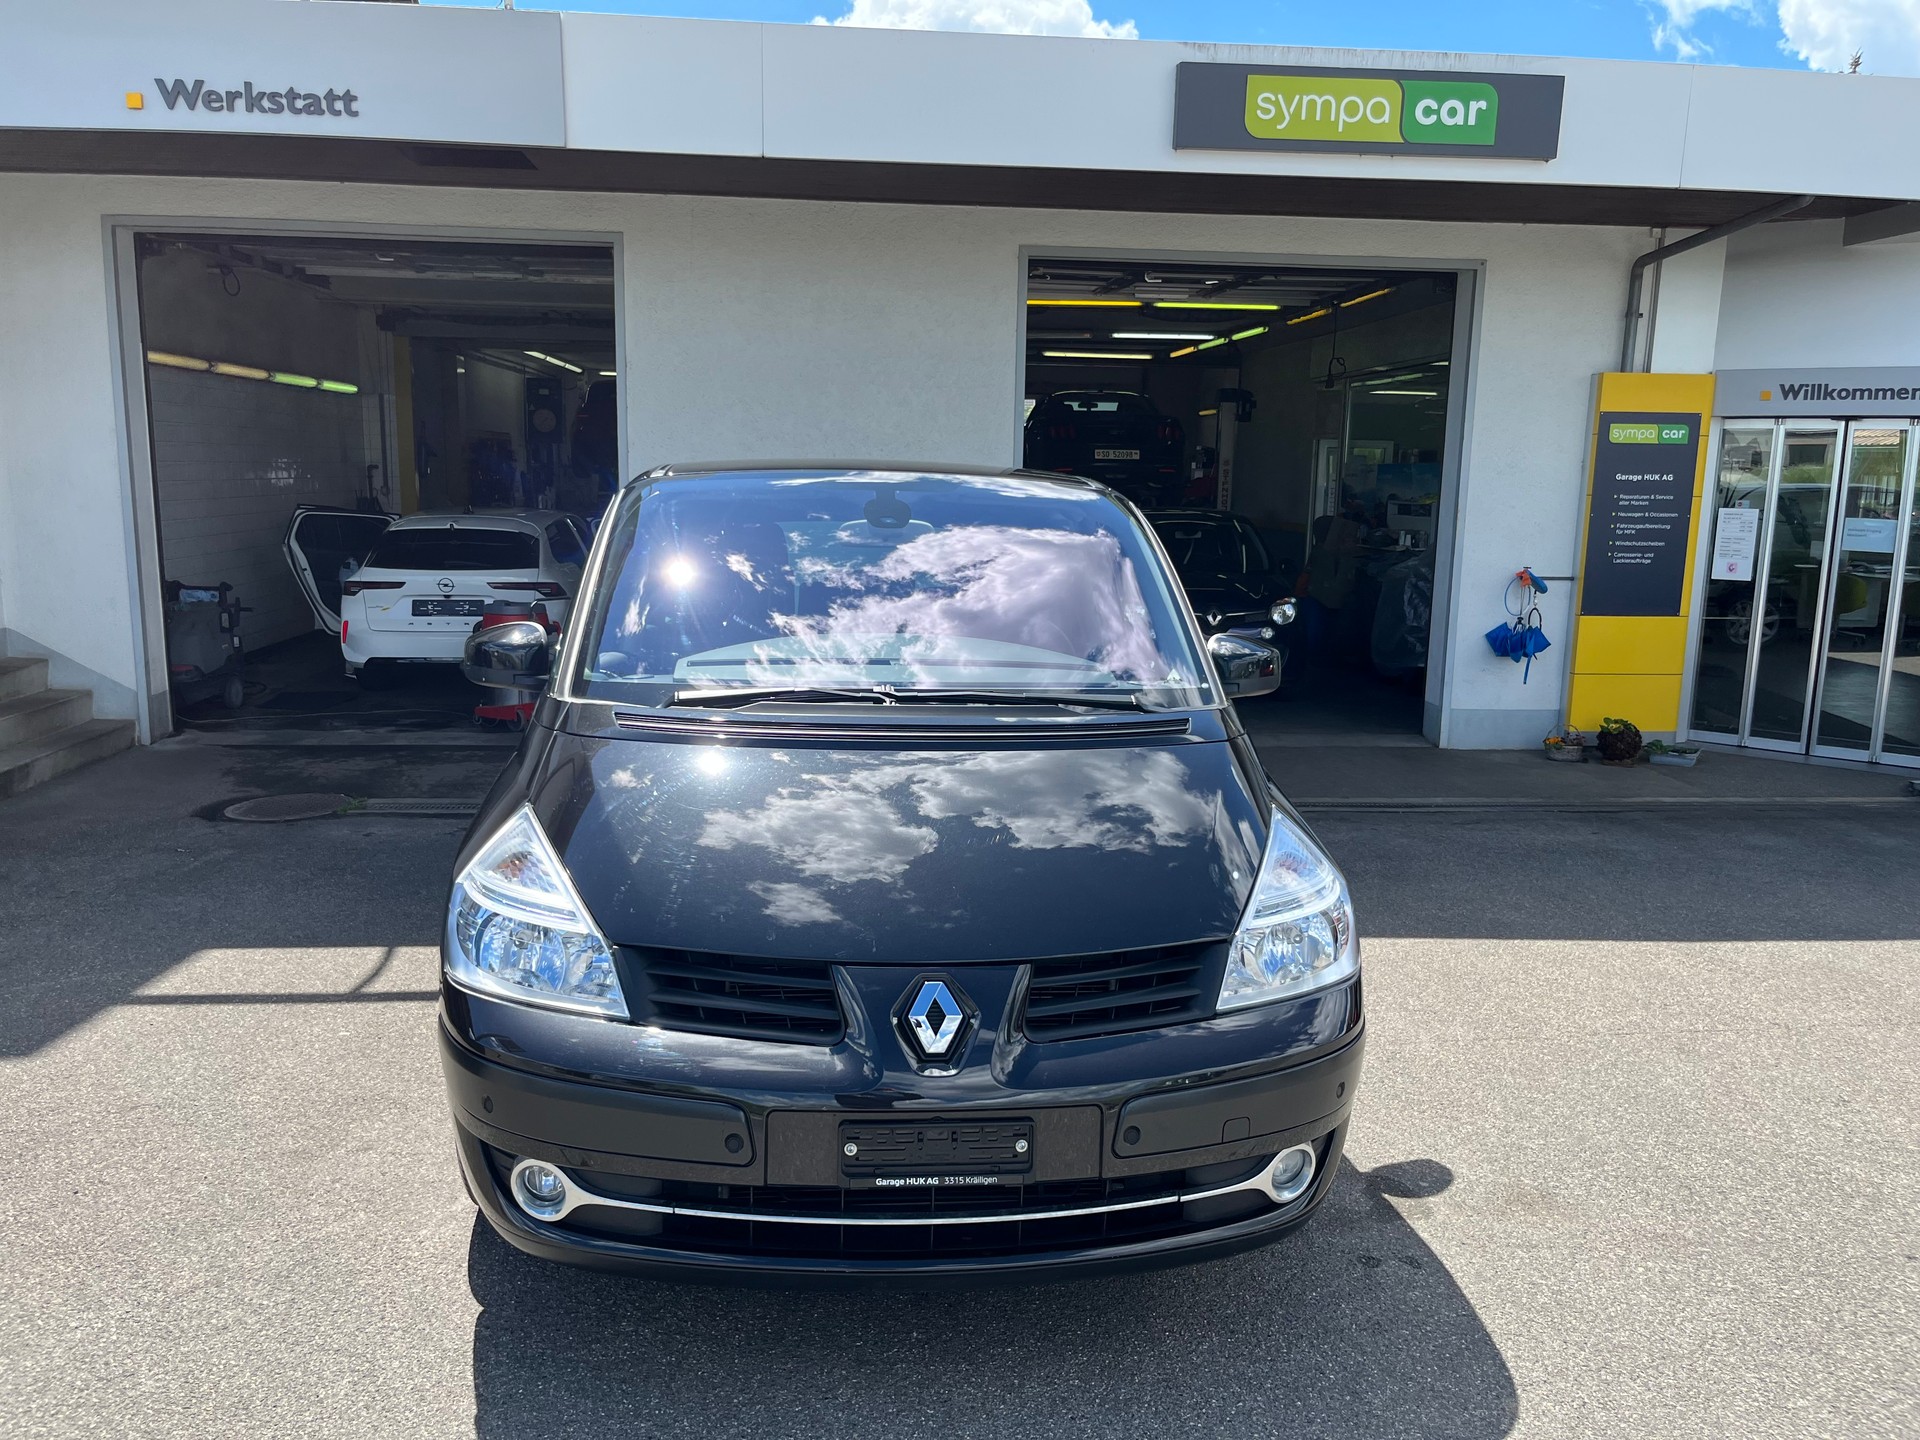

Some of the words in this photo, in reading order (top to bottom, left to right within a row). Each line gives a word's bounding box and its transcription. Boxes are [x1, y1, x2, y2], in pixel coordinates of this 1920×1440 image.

[154, 78, 359, 117] Werkstatt
[1256, 92, 1389, 132] sympa
[1414, 98, 1488, 126] car
[1612, 428, 1655, 441] sympa
[1662, 429, 1686, 439] car
[1615, 473, 1642, 482] Garage
[1643, 473, 1660, 481] HUK
[875, 1177, 905, 1187] Garage
[926, 1177, 939, 1185] AG
[944, 1176, 964, 1185] 3315
